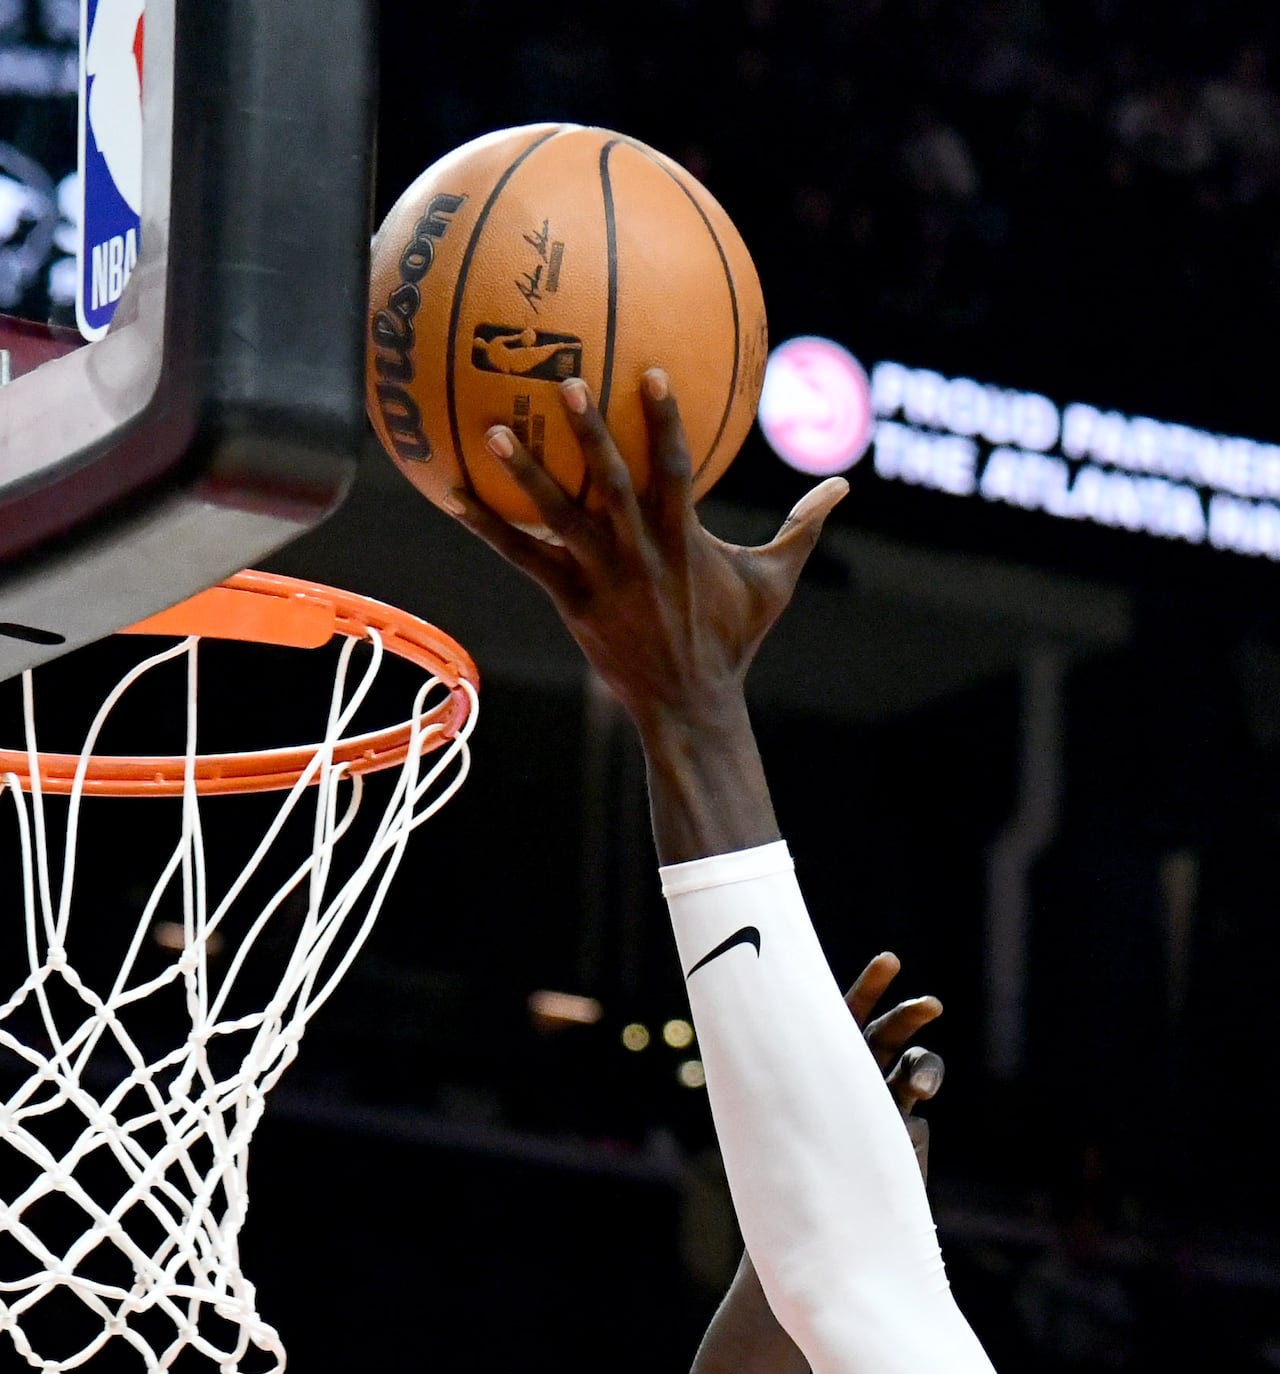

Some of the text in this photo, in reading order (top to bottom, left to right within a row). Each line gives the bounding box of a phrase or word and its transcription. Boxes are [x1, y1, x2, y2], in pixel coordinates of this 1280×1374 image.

[91, 229, 138, 310] NBA
[871, 361, 1059, 451] PROUD
[873, 418, 978, 497] THE
[980, 444, 1205, 545] ATLANTA
